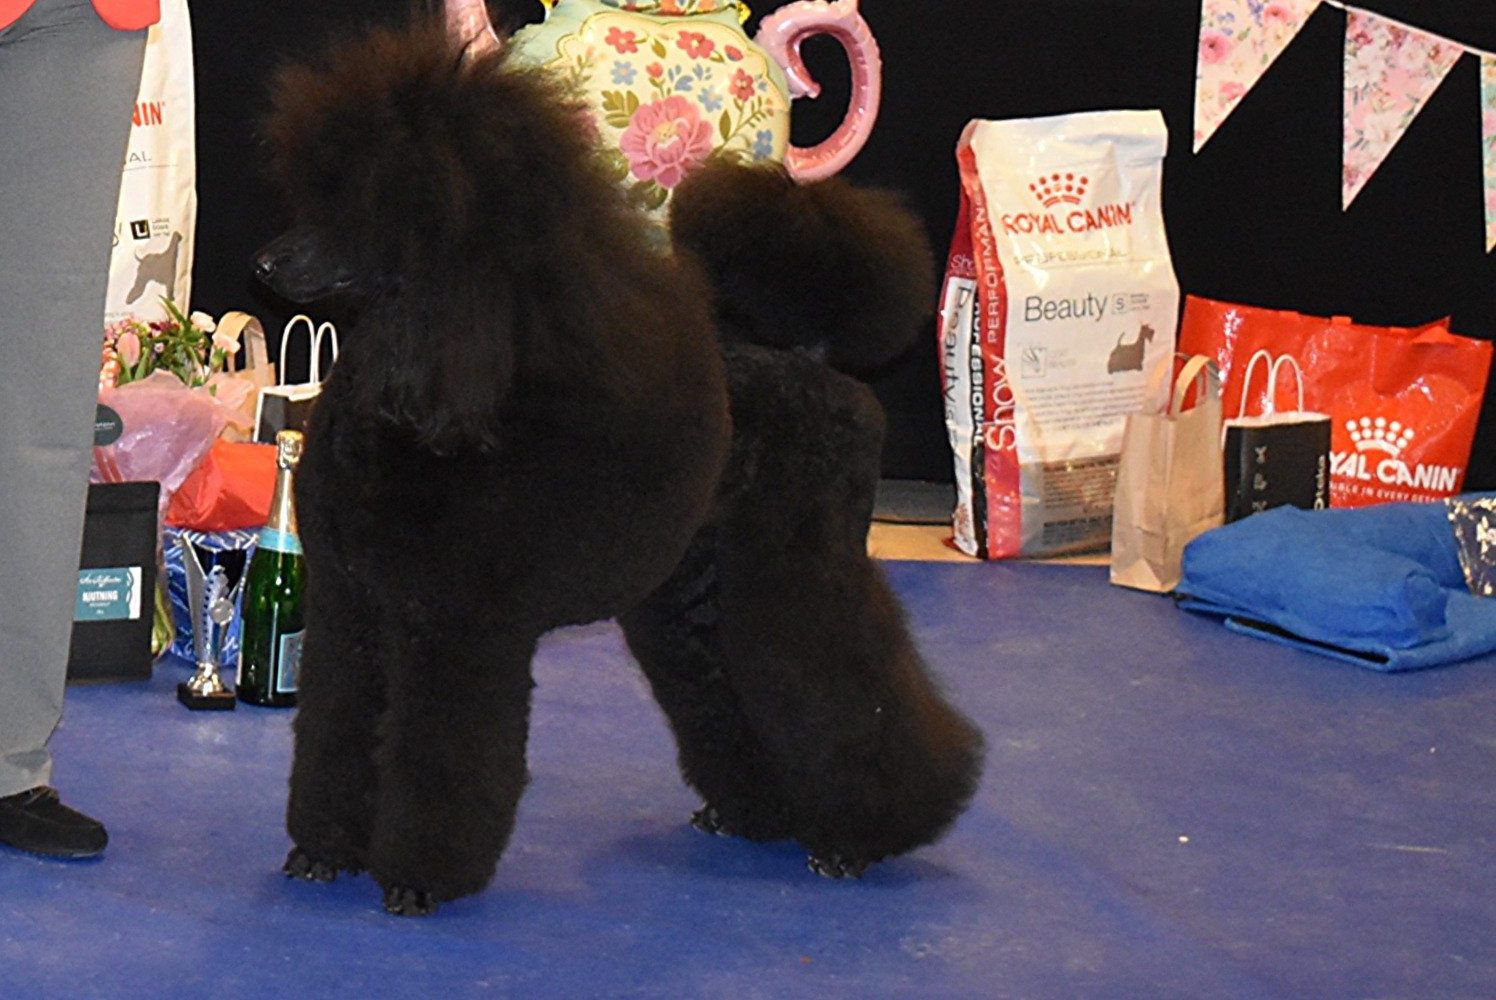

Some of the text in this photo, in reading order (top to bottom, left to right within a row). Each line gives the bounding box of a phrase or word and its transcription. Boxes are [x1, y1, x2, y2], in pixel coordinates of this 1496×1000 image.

[1001, 203, 1133, 236] ROYAL CANIN
[1024, 292, 1108, 323] Beauty
[986, 353, 1018, 451] Show
[1330, 451, 1371, 480] YAL
[1376, 459, 1458, 492] CANIN
